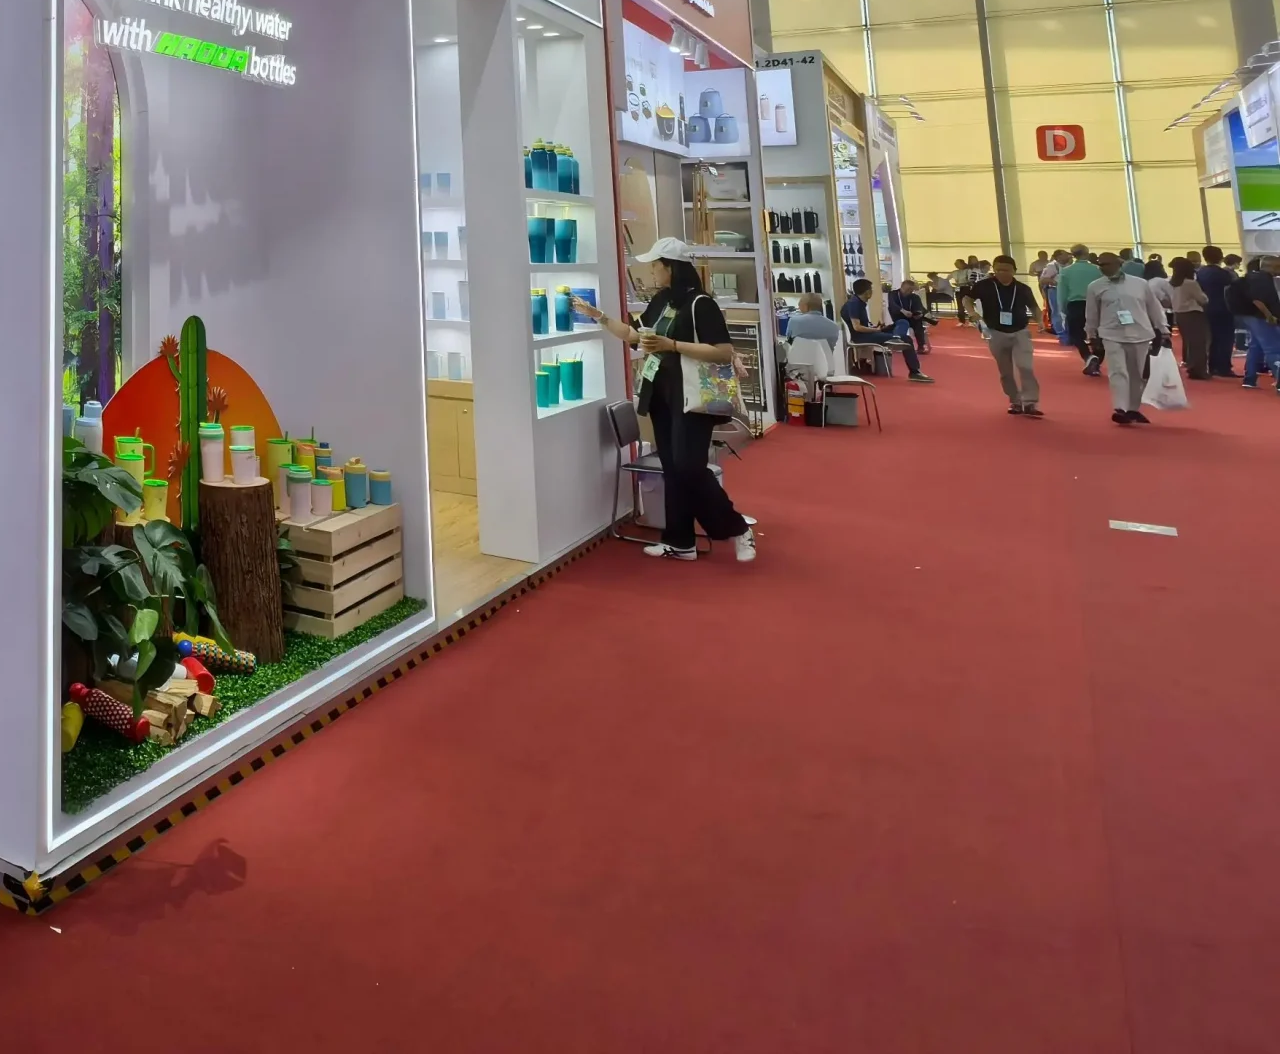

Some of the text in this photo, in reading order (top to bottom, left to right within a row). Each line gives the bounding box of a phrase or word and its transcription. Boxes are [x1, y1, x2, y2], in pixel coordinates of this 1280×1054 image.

[255, 10, 293, 41] water
[102, 17, 153, 52] with
[250, 45, 298, 86] bottles
[754, 55, 815, 68] 1.2D41-42
[1045, 129, 1076, 157] D
